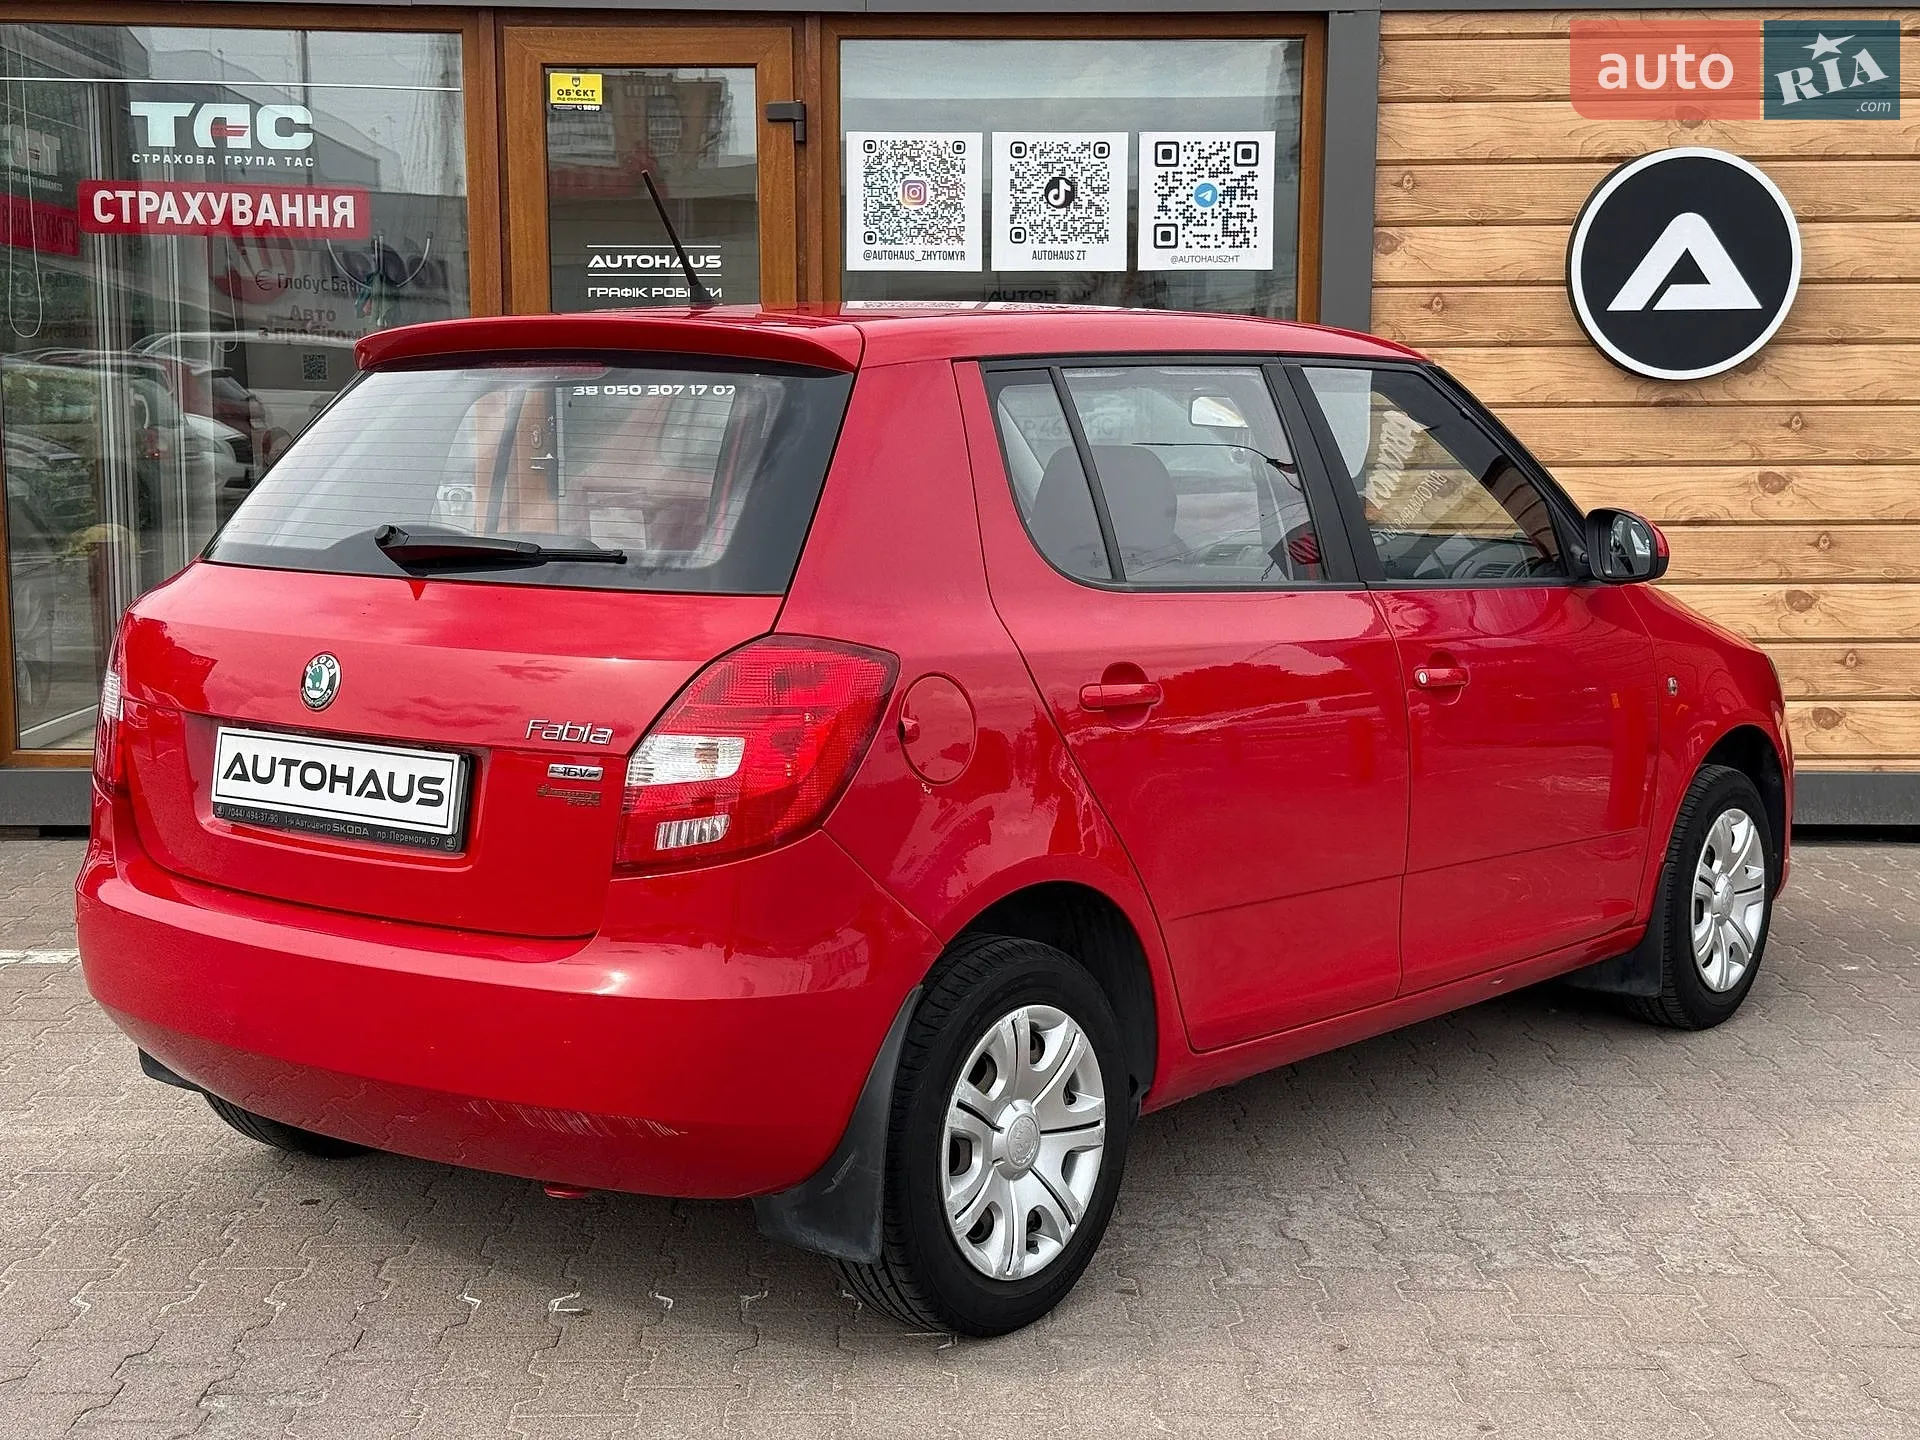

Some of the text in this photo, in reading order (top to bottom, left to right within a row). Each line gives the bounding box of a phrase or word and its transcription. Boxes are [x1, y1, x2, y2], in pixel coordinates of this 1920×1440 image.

[131, 154, 314, 167] СТРАХОВА ГРУПА ТАС
[93, 190, 355, 229] СТРАХУВАННЯ
[862, 249, 966, 262] @AUTOHAUS_ZHYTOMYR
[1031, 250, 1087, 261] AUTOHAUS ZT
[1170, 255, 1241, 265] @AUTOHAUSZHT
[277, 273, 330, 294] Глобус
[587, 287, 649, 298] ГРАФІК
[572, 384, 736, 396] 38 050 307 17 07
[525, 719, 614, 745] Fabia
[222, 751, 445, 807] AUTOHAUS
[430, 837, 440, 846] 67
